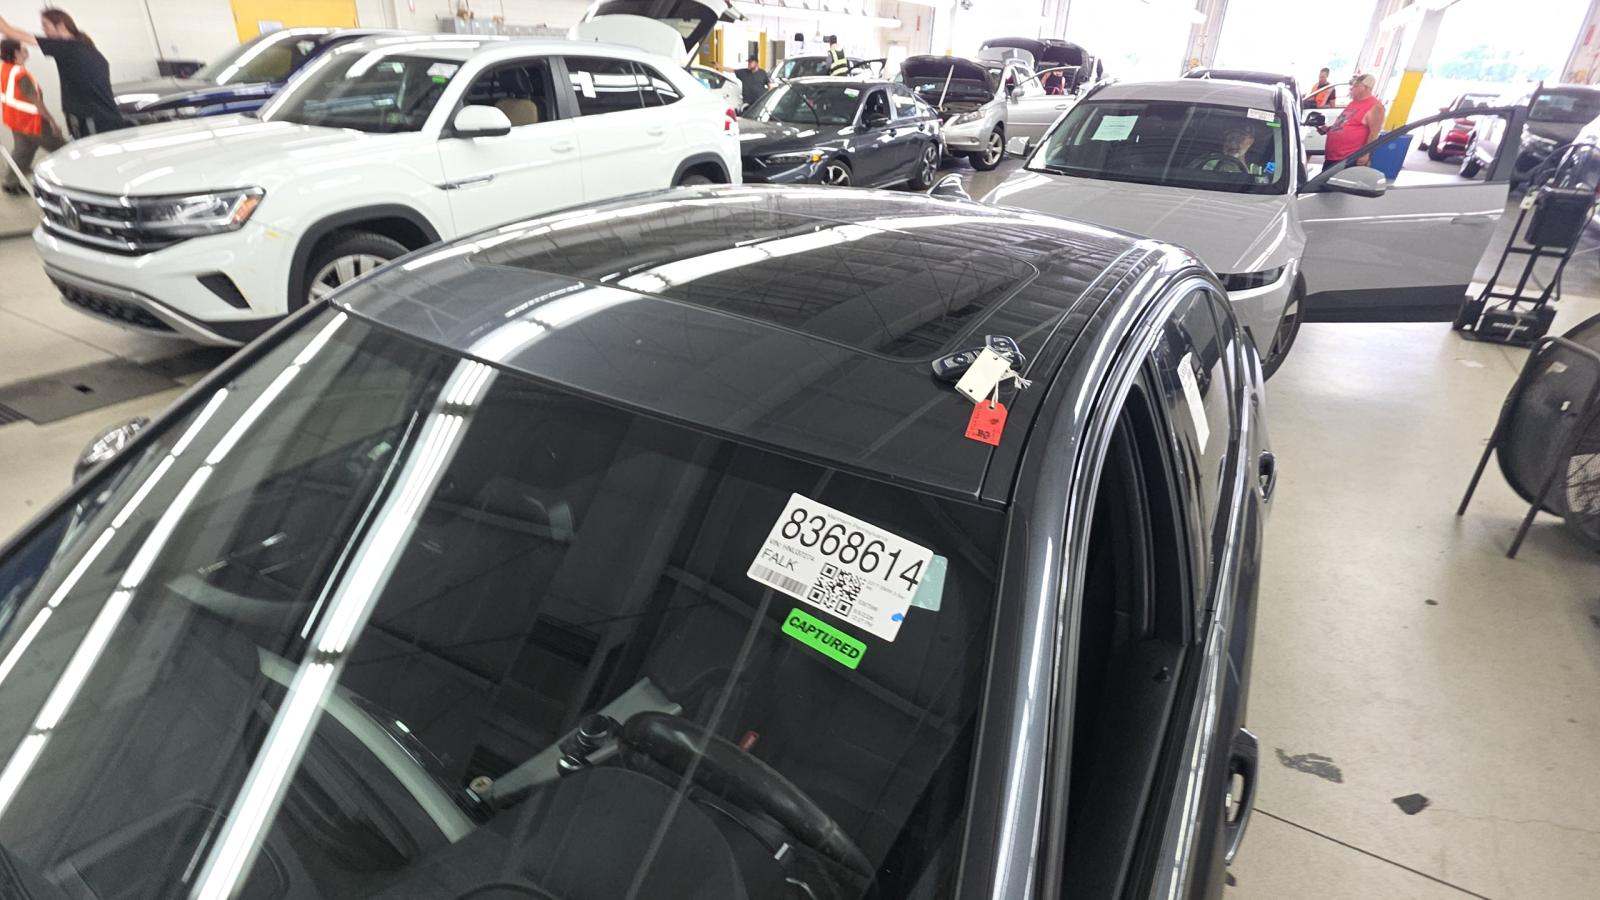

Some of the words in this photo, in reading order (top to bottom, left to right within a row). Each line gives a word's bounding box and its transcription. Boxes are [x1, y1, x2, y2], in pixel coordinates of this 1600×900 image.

[761, 548, 799, 572] FALK
[782, 508, 924, 591] 8368614
[788, 616, 860, 660] CAPTURED
